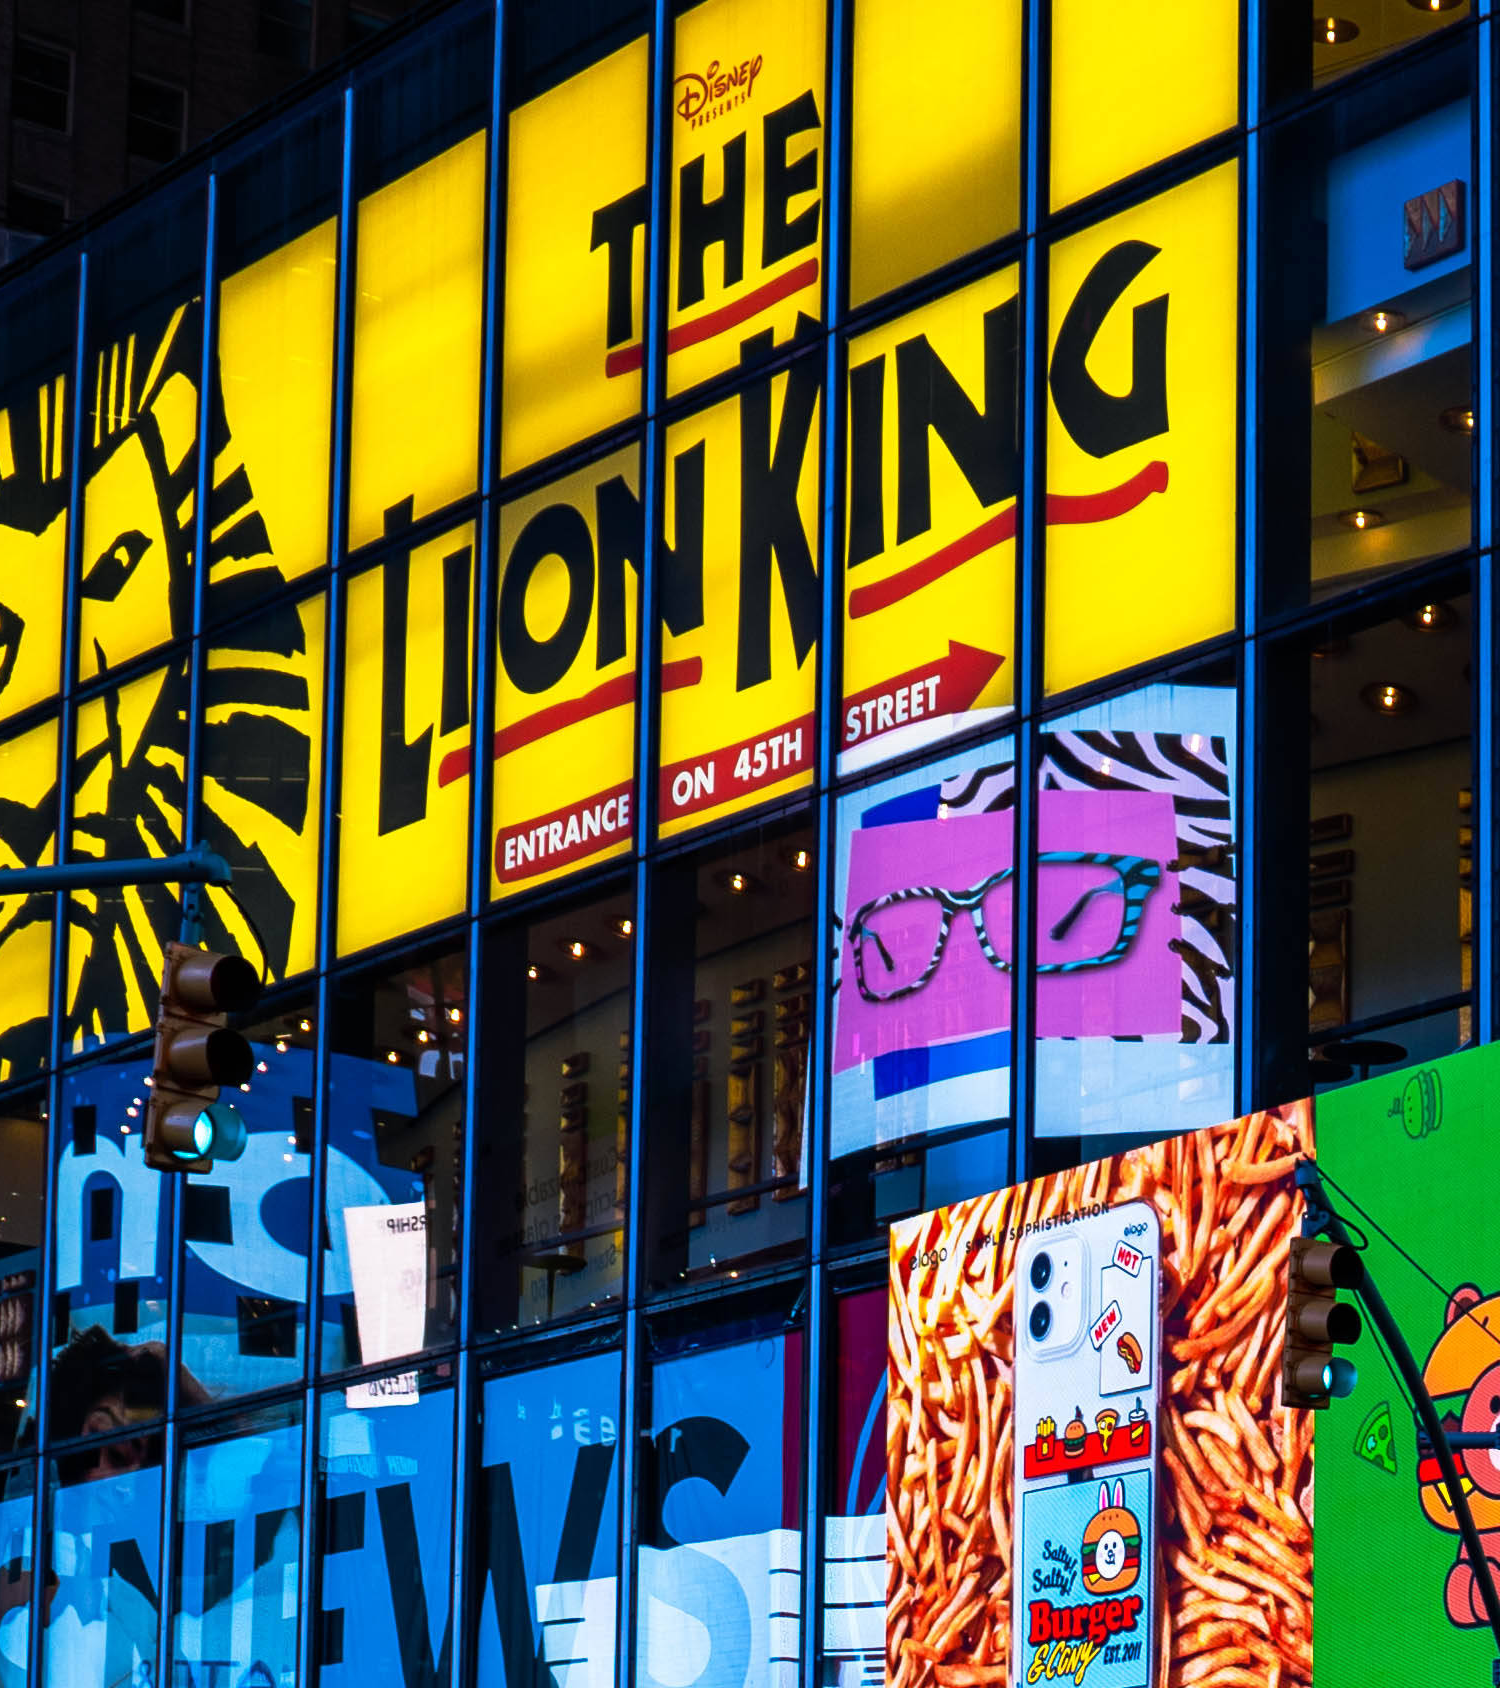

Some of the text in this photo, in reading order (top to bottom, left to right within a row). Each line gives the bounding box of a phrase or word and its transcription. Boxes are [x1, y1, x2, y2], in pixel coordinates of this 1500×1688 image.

[691, 91, 753, 130] PRESENTS
[590, 88, 821, 349] THE
[378, 238, 1170, 836] LION KING
[503, 676, 941, 871] ENTRANCE ON 45TH STREET
[1009, 1203, 1110, 1241] SOPHISTICATION
[1124, 1221, 1148, 1237] elago
[1117, 1249, 1139, 1270] HOT
[1094, 1310, 1117, 1343] NEW
[1043, 1540, 1077, 1572] Salty!
[1032, 1568, 1077, 1596] Salty!
[1029, 1595, 1142, 1645] Burger
[1122, 1641, 1143, 1662] 2011
